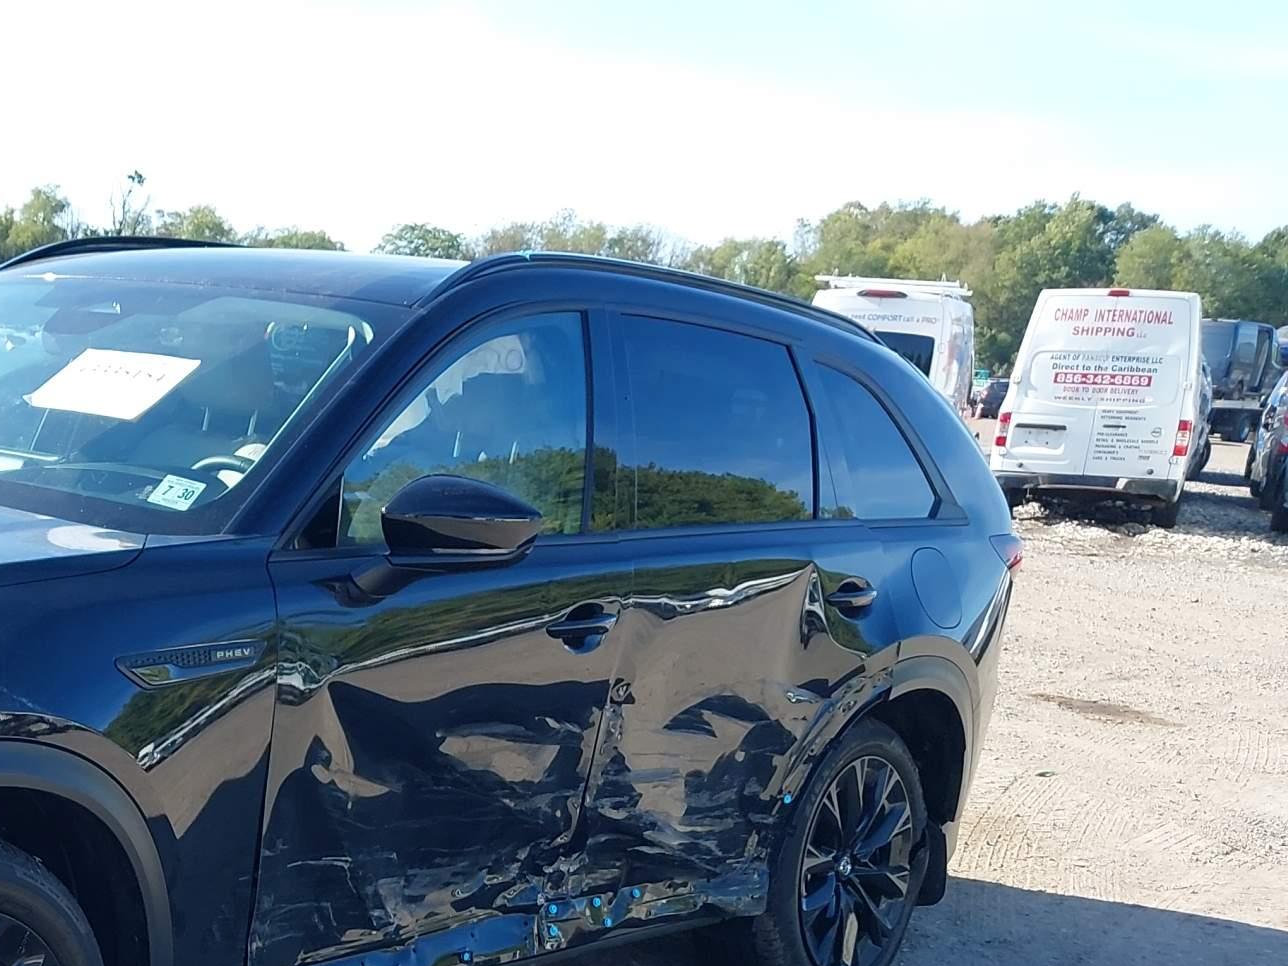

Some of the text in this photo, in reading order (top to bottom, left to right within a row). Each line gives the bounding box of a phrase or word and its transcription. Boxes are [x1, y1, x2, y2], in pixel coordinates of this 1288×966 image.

[867, 313, 902, 322] COMFORT
[1054, 308, 1174, 325] CHAMP INTERNATIONAL
[1072, 326, 1136, 338] SHIPPING
[1050, 353, 1071, 361] AGENT
[1111, 355, 1150, 364] ENTERPRISE
[1151, 356, 1164, 365] LLC
[1052, 362, 1158, 374] Direct to the Caribbean
[1056, 373, 1150, 386] 856-342-6869
[1110, 387, 1139, 395] DELIVERY
[162, 485, 174, 496] 7
[177, 488, 195, 501] 30
[216, 648, 250, 659] PHEV
